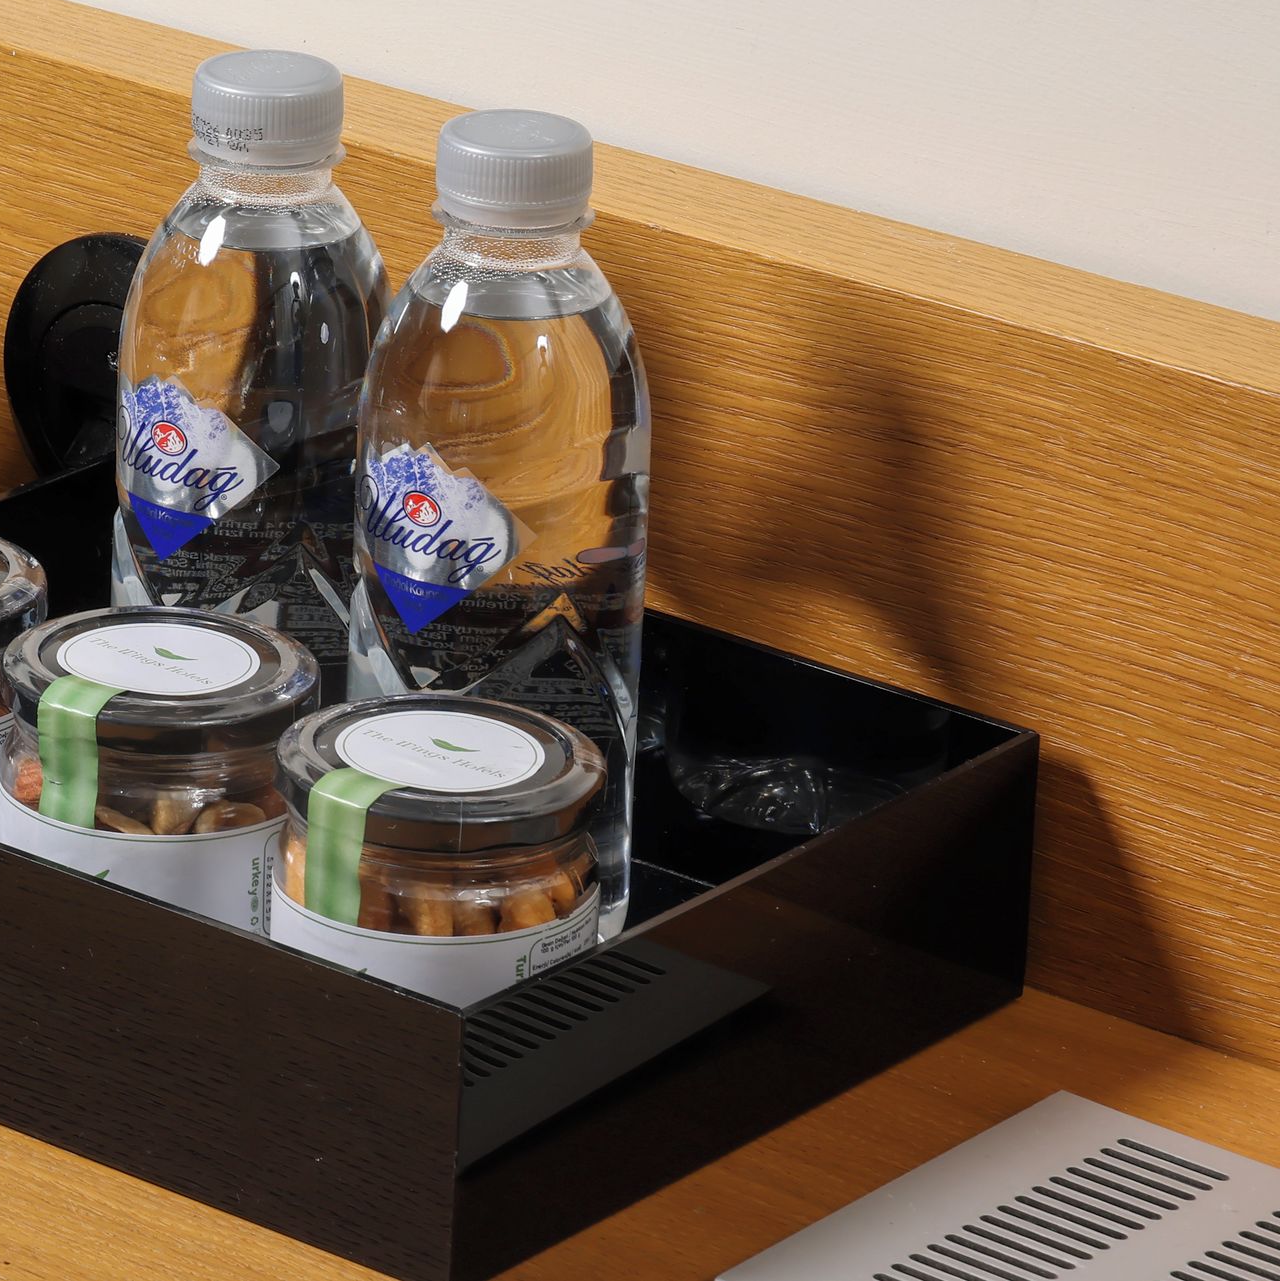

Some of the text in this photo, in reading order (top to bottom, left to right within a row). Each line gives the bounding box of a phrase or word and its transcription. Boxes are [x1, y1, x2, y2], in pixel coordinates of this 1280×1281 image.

[360, 474, 502, 584] Uludağ
[90, 638, 118, 650] The
[118, 648, 165, 667] Wings
[363, 729, 506, 779] The Wings Hotels
